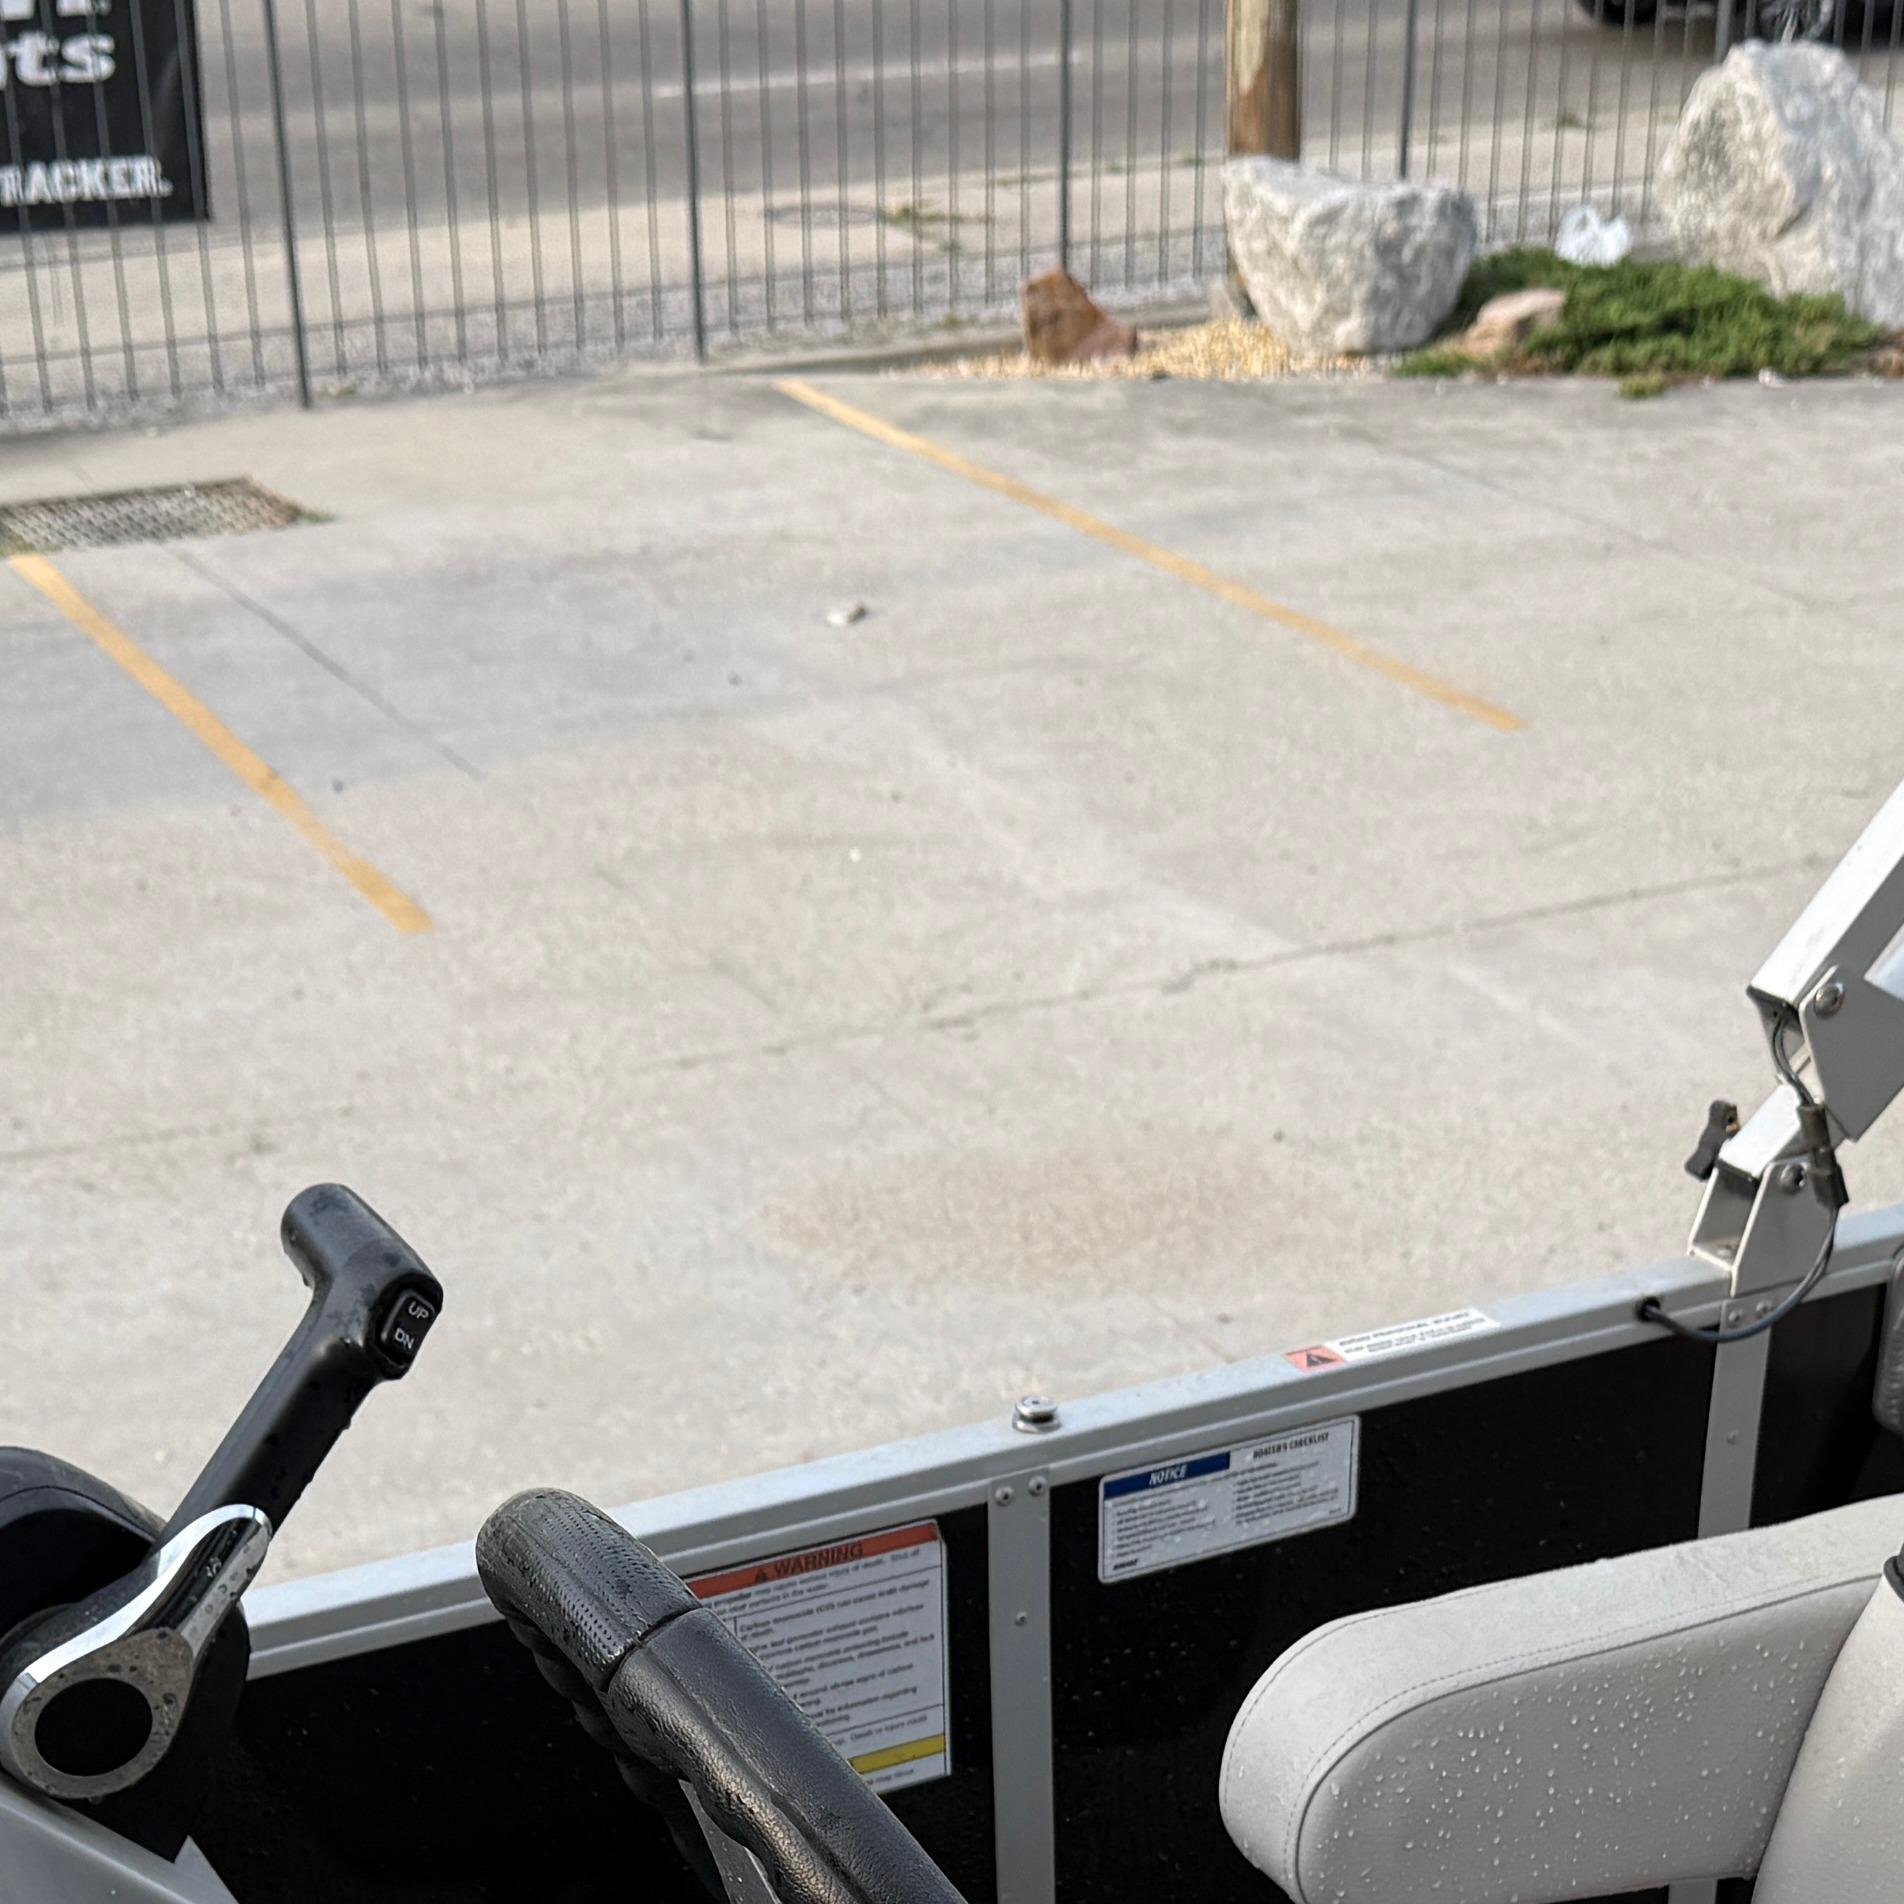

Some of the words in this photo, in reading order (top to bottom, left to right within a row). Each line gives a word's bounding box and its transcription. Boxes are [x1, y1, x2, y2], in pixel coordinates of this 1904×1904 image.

[408, 1300, 429, 1319] UP
[395, 1327, 414, 1349] DN
[1149, 1464, 1188, 1486] NOTICE
[773, 1542, 863, 1578] WARNING
